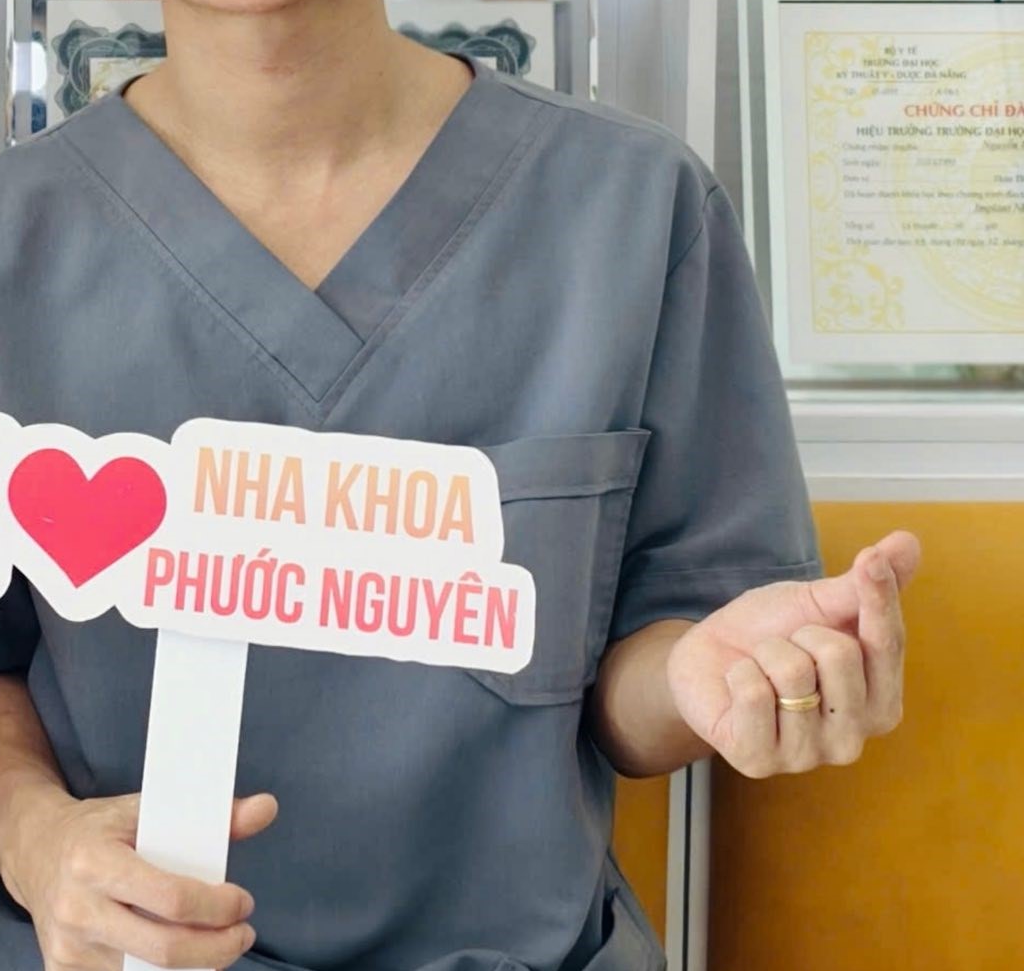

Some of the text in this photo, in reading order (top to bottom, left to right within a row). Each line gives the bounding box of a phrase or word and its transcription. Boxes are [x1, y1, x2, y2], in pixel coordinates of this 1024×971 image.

[193, 446, 476, 545] NHA KHOA
[142, 547, 520, 650] PHƯỚC NGUYÊN
